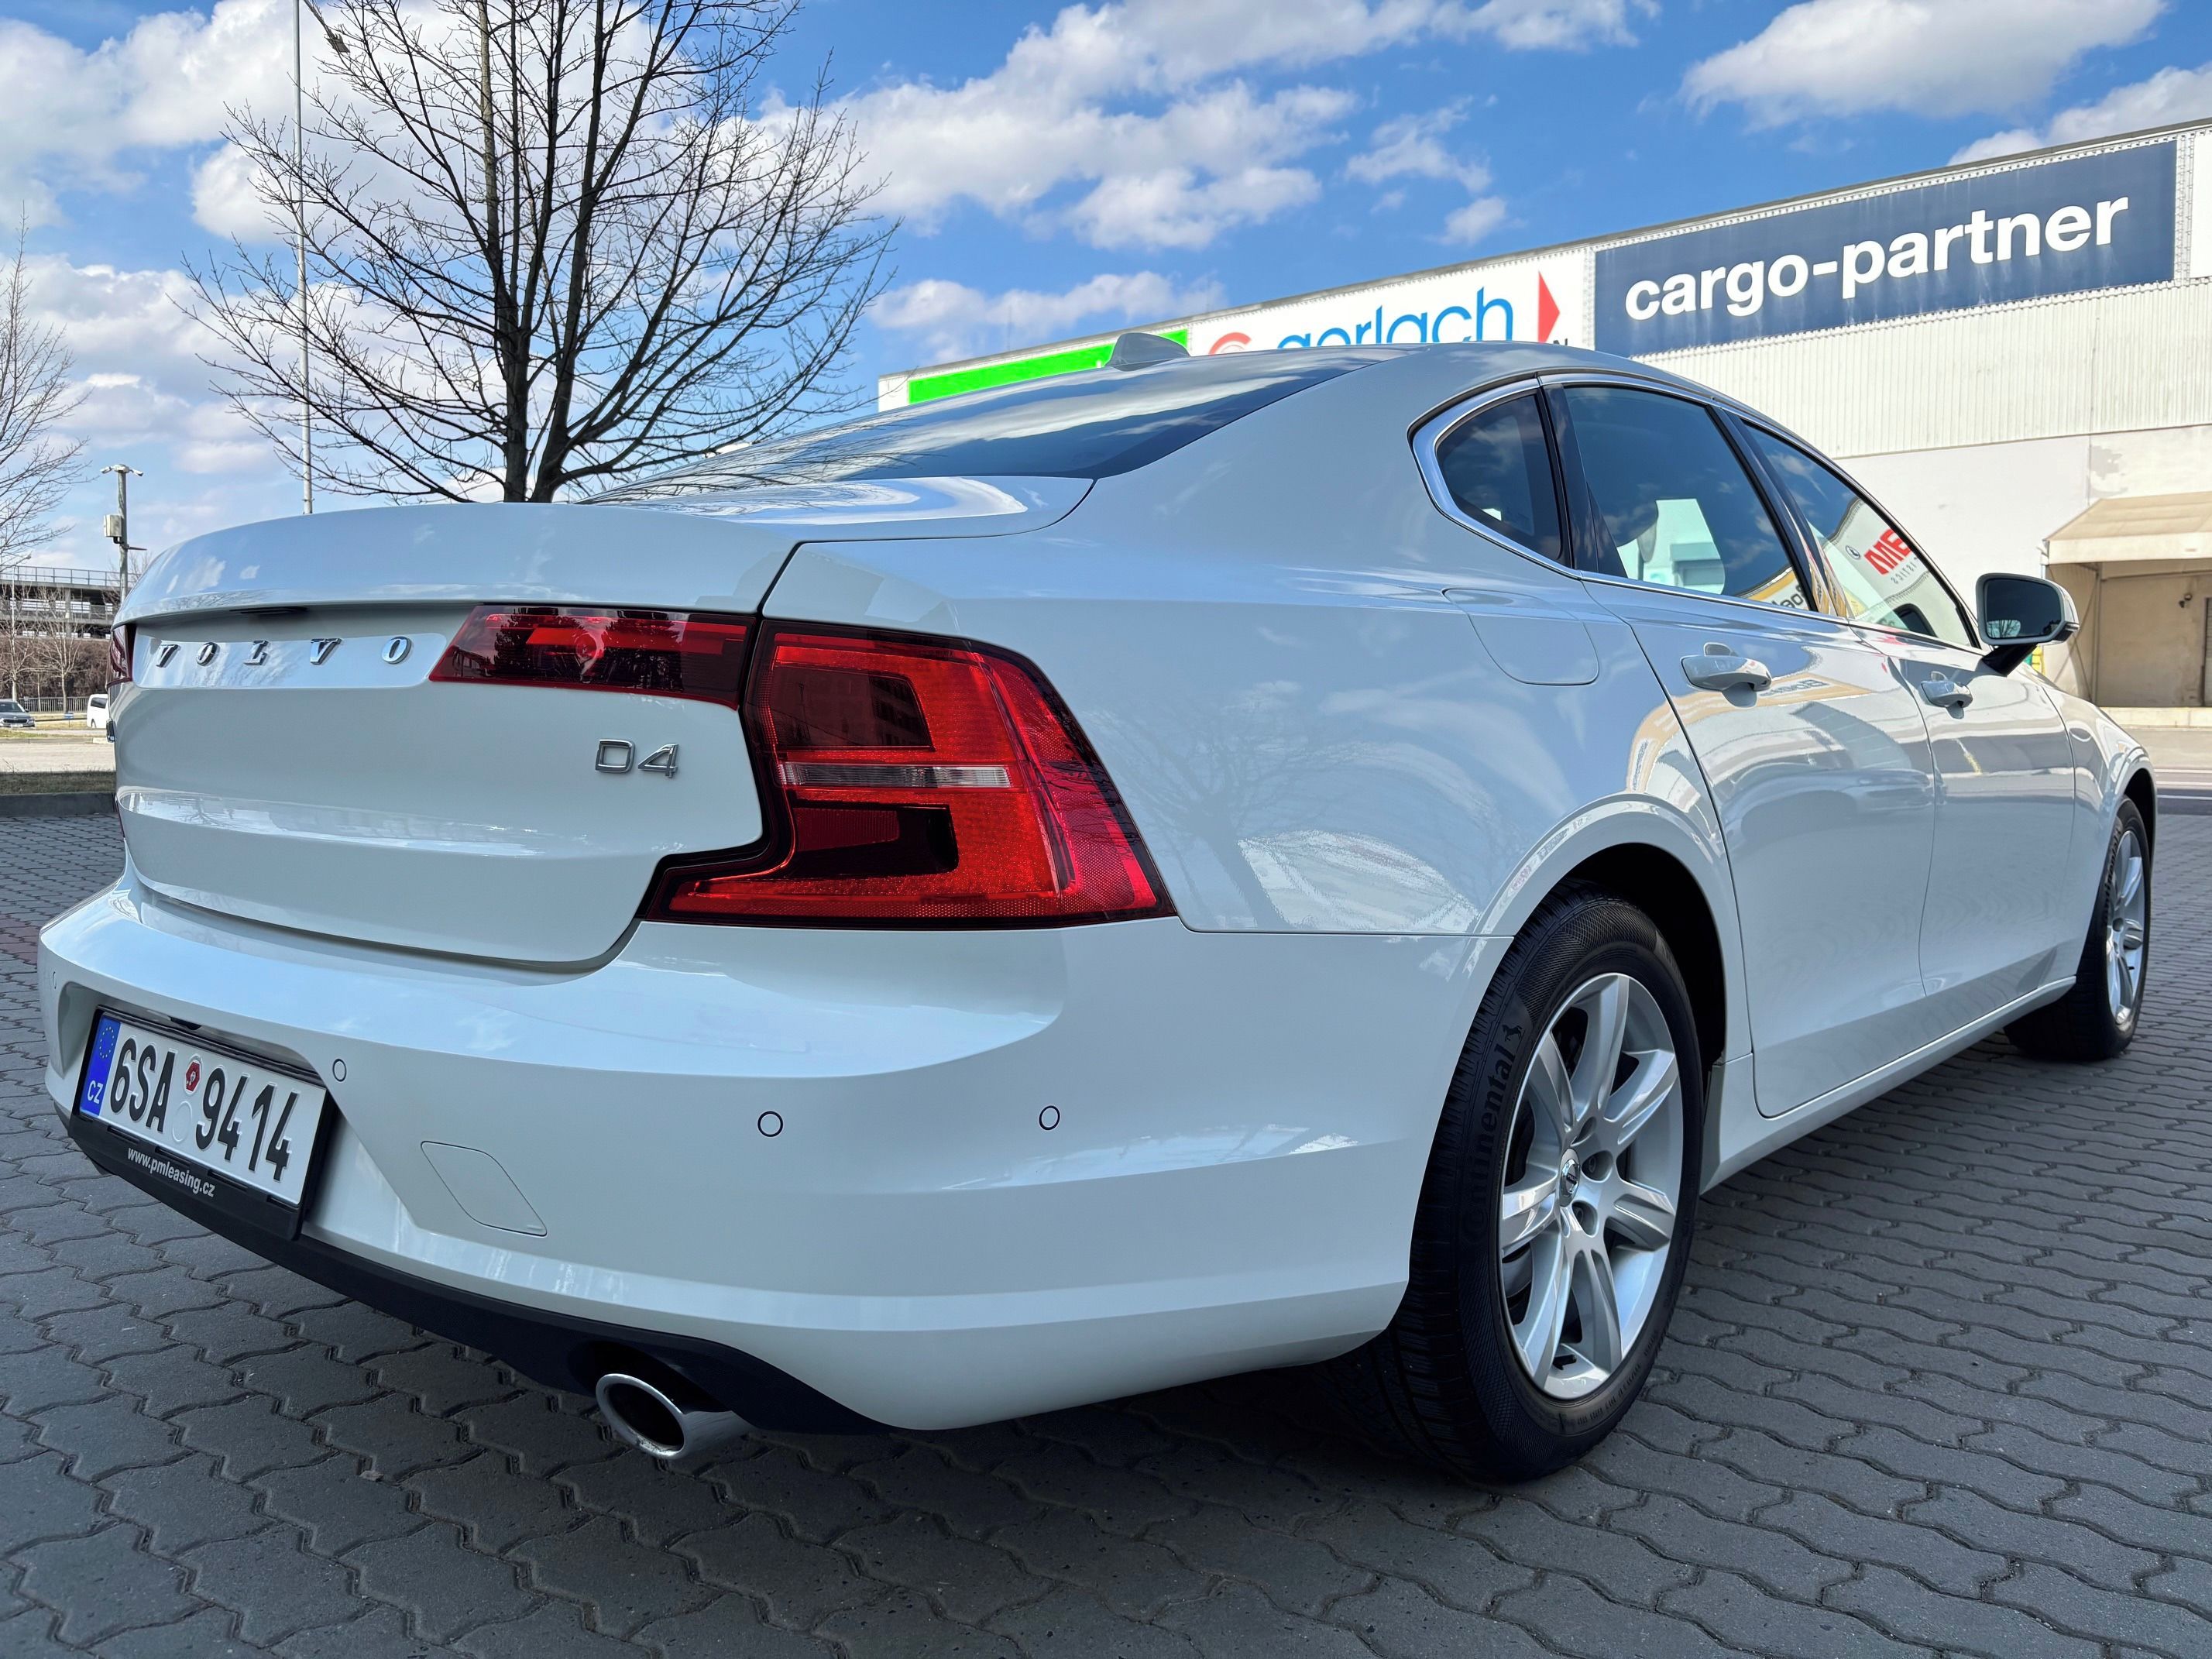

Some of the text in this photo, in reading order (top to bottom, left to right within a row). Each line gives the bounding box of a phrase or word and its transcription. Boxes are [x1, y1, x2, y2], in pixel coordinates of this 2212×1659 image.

[1625, 197, 2129, 320] cargo-partner
[1277, 287, 1513, 349] rlach
[154, 636, 412, 668] VOLVO
[594, 738, 680, 778] D4
[87, 1080, 104, 1104] CZ
[109, 1037, 300, 1182] 6SA 9414
[128, 1147, 216, 1197] www.pmleasing.cz
